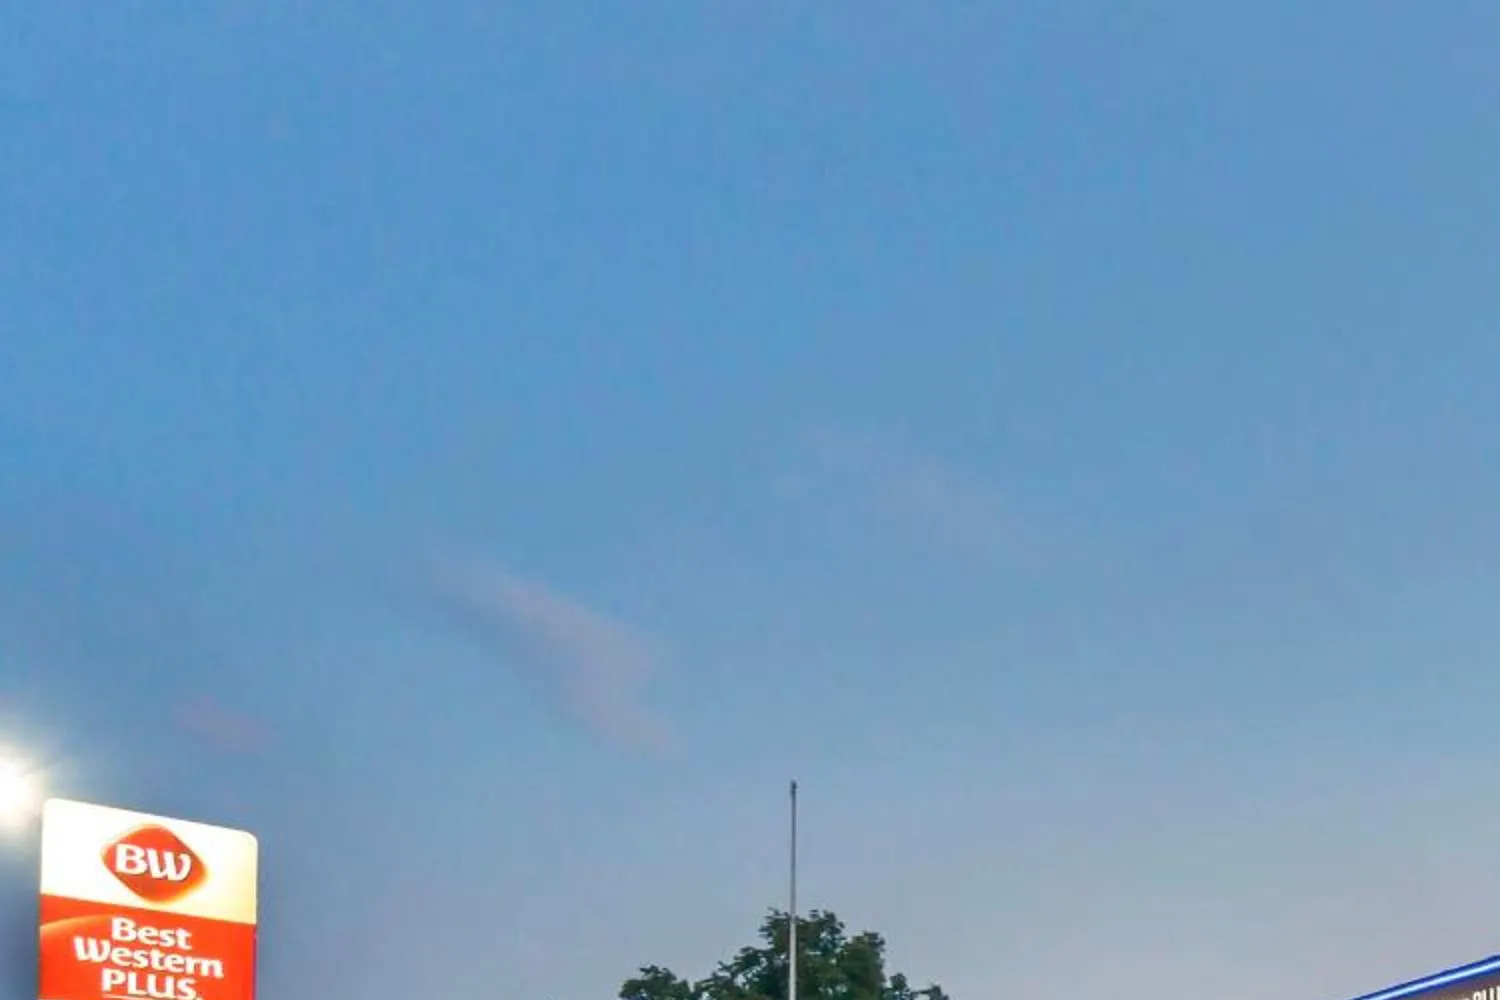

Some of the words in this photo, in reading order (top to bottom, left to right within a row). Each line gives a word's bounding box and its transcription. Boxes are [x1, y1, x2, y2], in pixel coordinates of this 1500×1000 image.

[115, 843, 192, 881] BW
[111, 916, 192, 950] Best
[73, 935, 224, 979] Western
